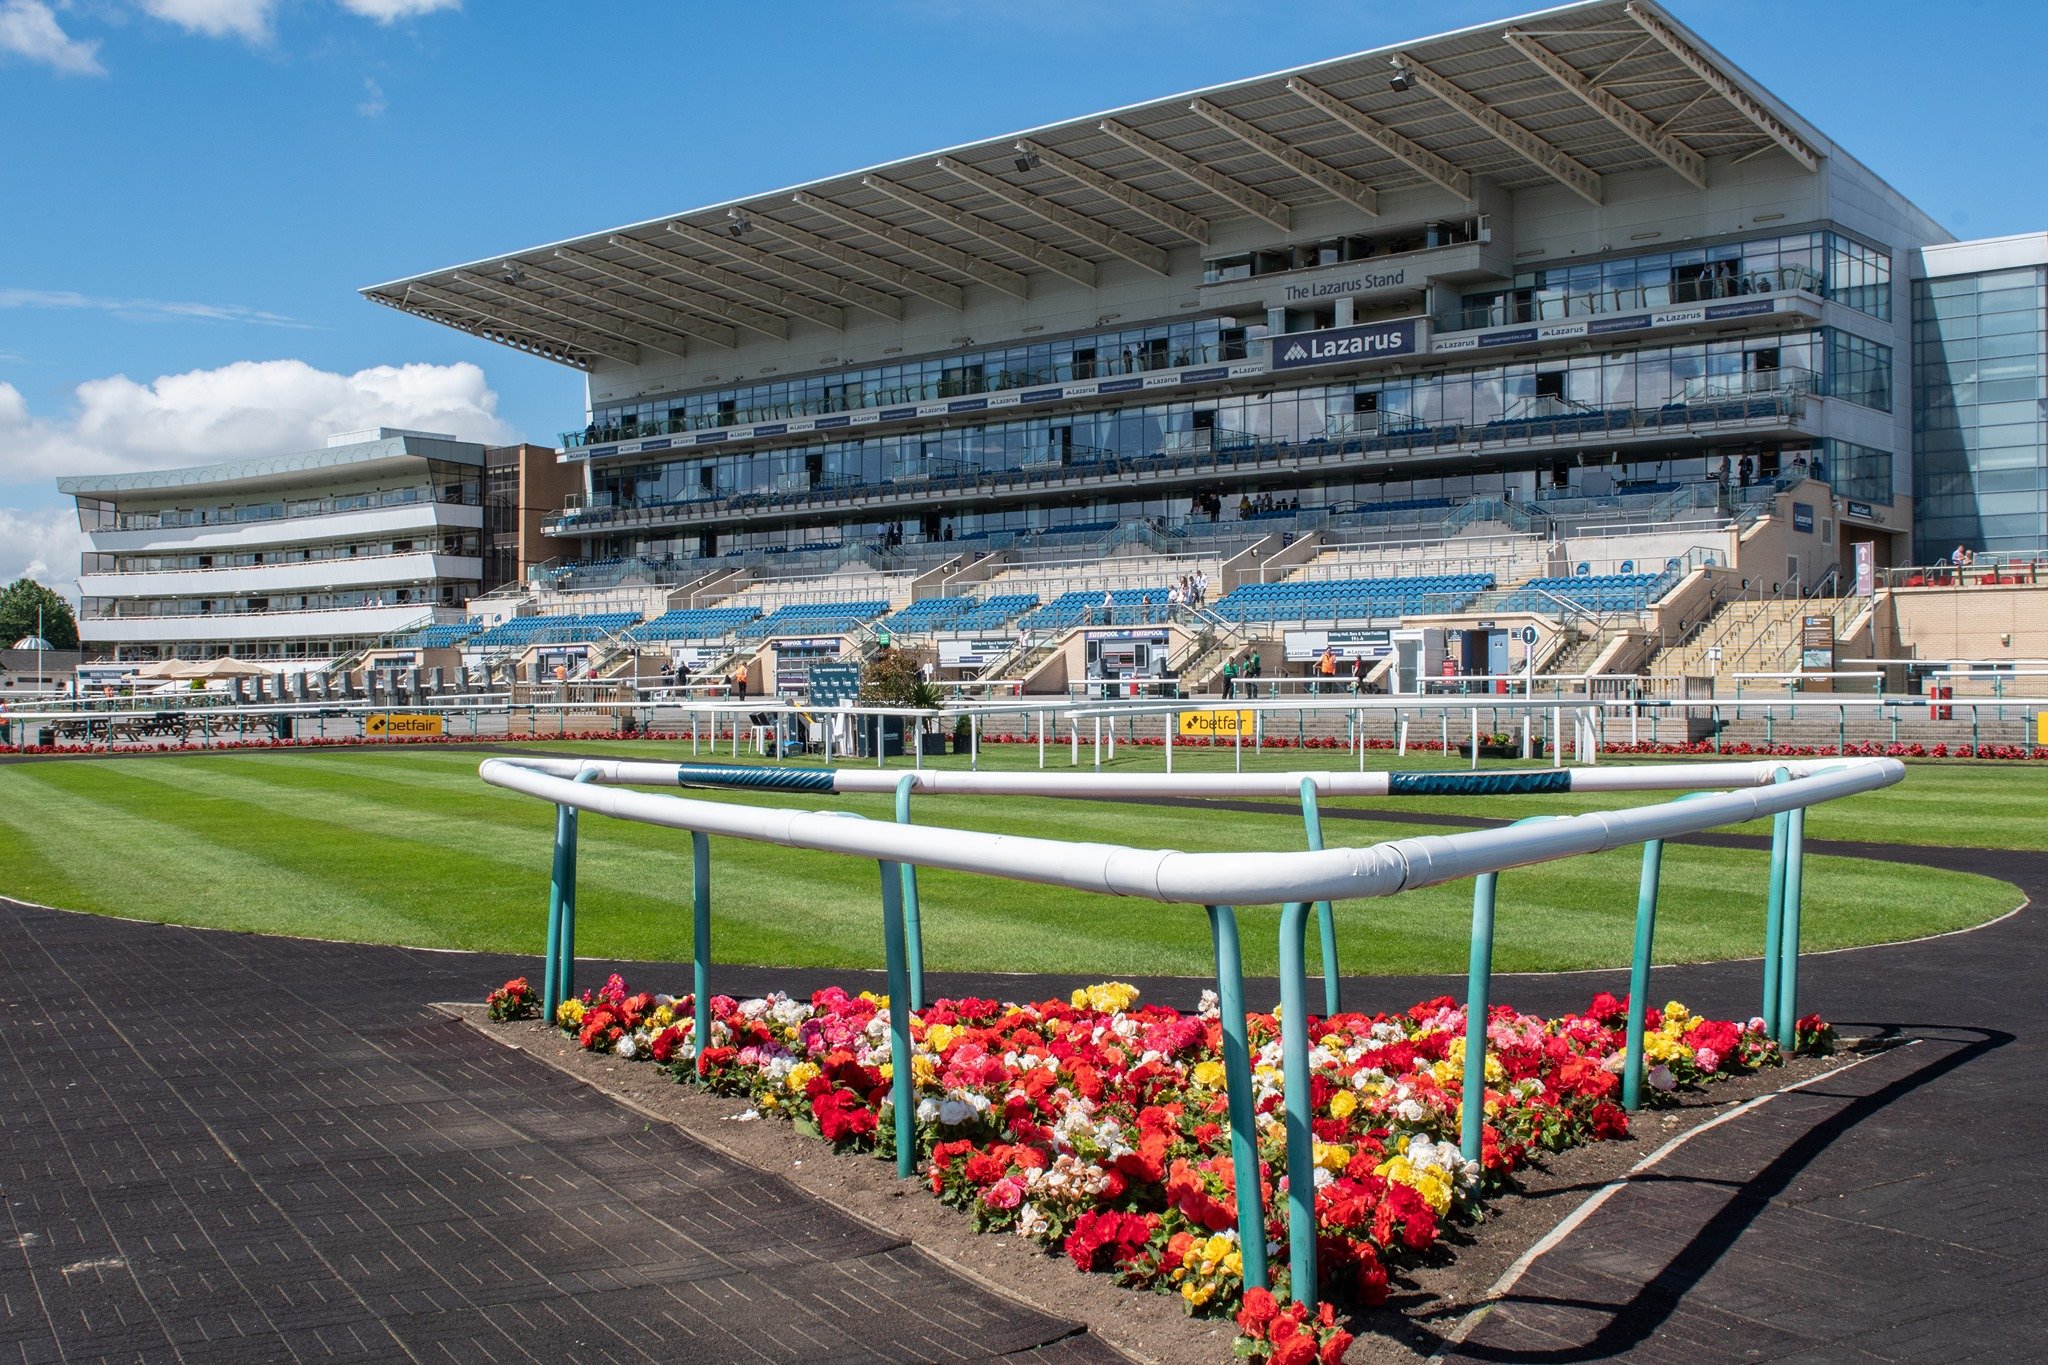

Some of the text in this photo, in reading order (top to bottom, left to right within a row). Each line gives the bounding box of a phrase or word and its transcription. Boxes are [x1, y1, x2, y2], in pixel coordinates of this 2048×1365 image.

[1285, 269, 1404, 300] The Lazarus Stand
[1710, 304, 1768, 316] lazarusproperties.co.uk
[1666, 312, 1700, 322] Lazarus
[1551, 326, 1584, 336] Lazarus
[1311, 332, 1402, 359] Lazarus
[1444, 340, 1475, 349] Lazarus
[1153, 376, 1178, 385] Lazarus
[1860, 506, 1869, 514] Court
[1795, 514, 1812, 524] Lazarus
[388, 720, 435, 731] betfair
[1200, 716, 1246, 730] betfar
